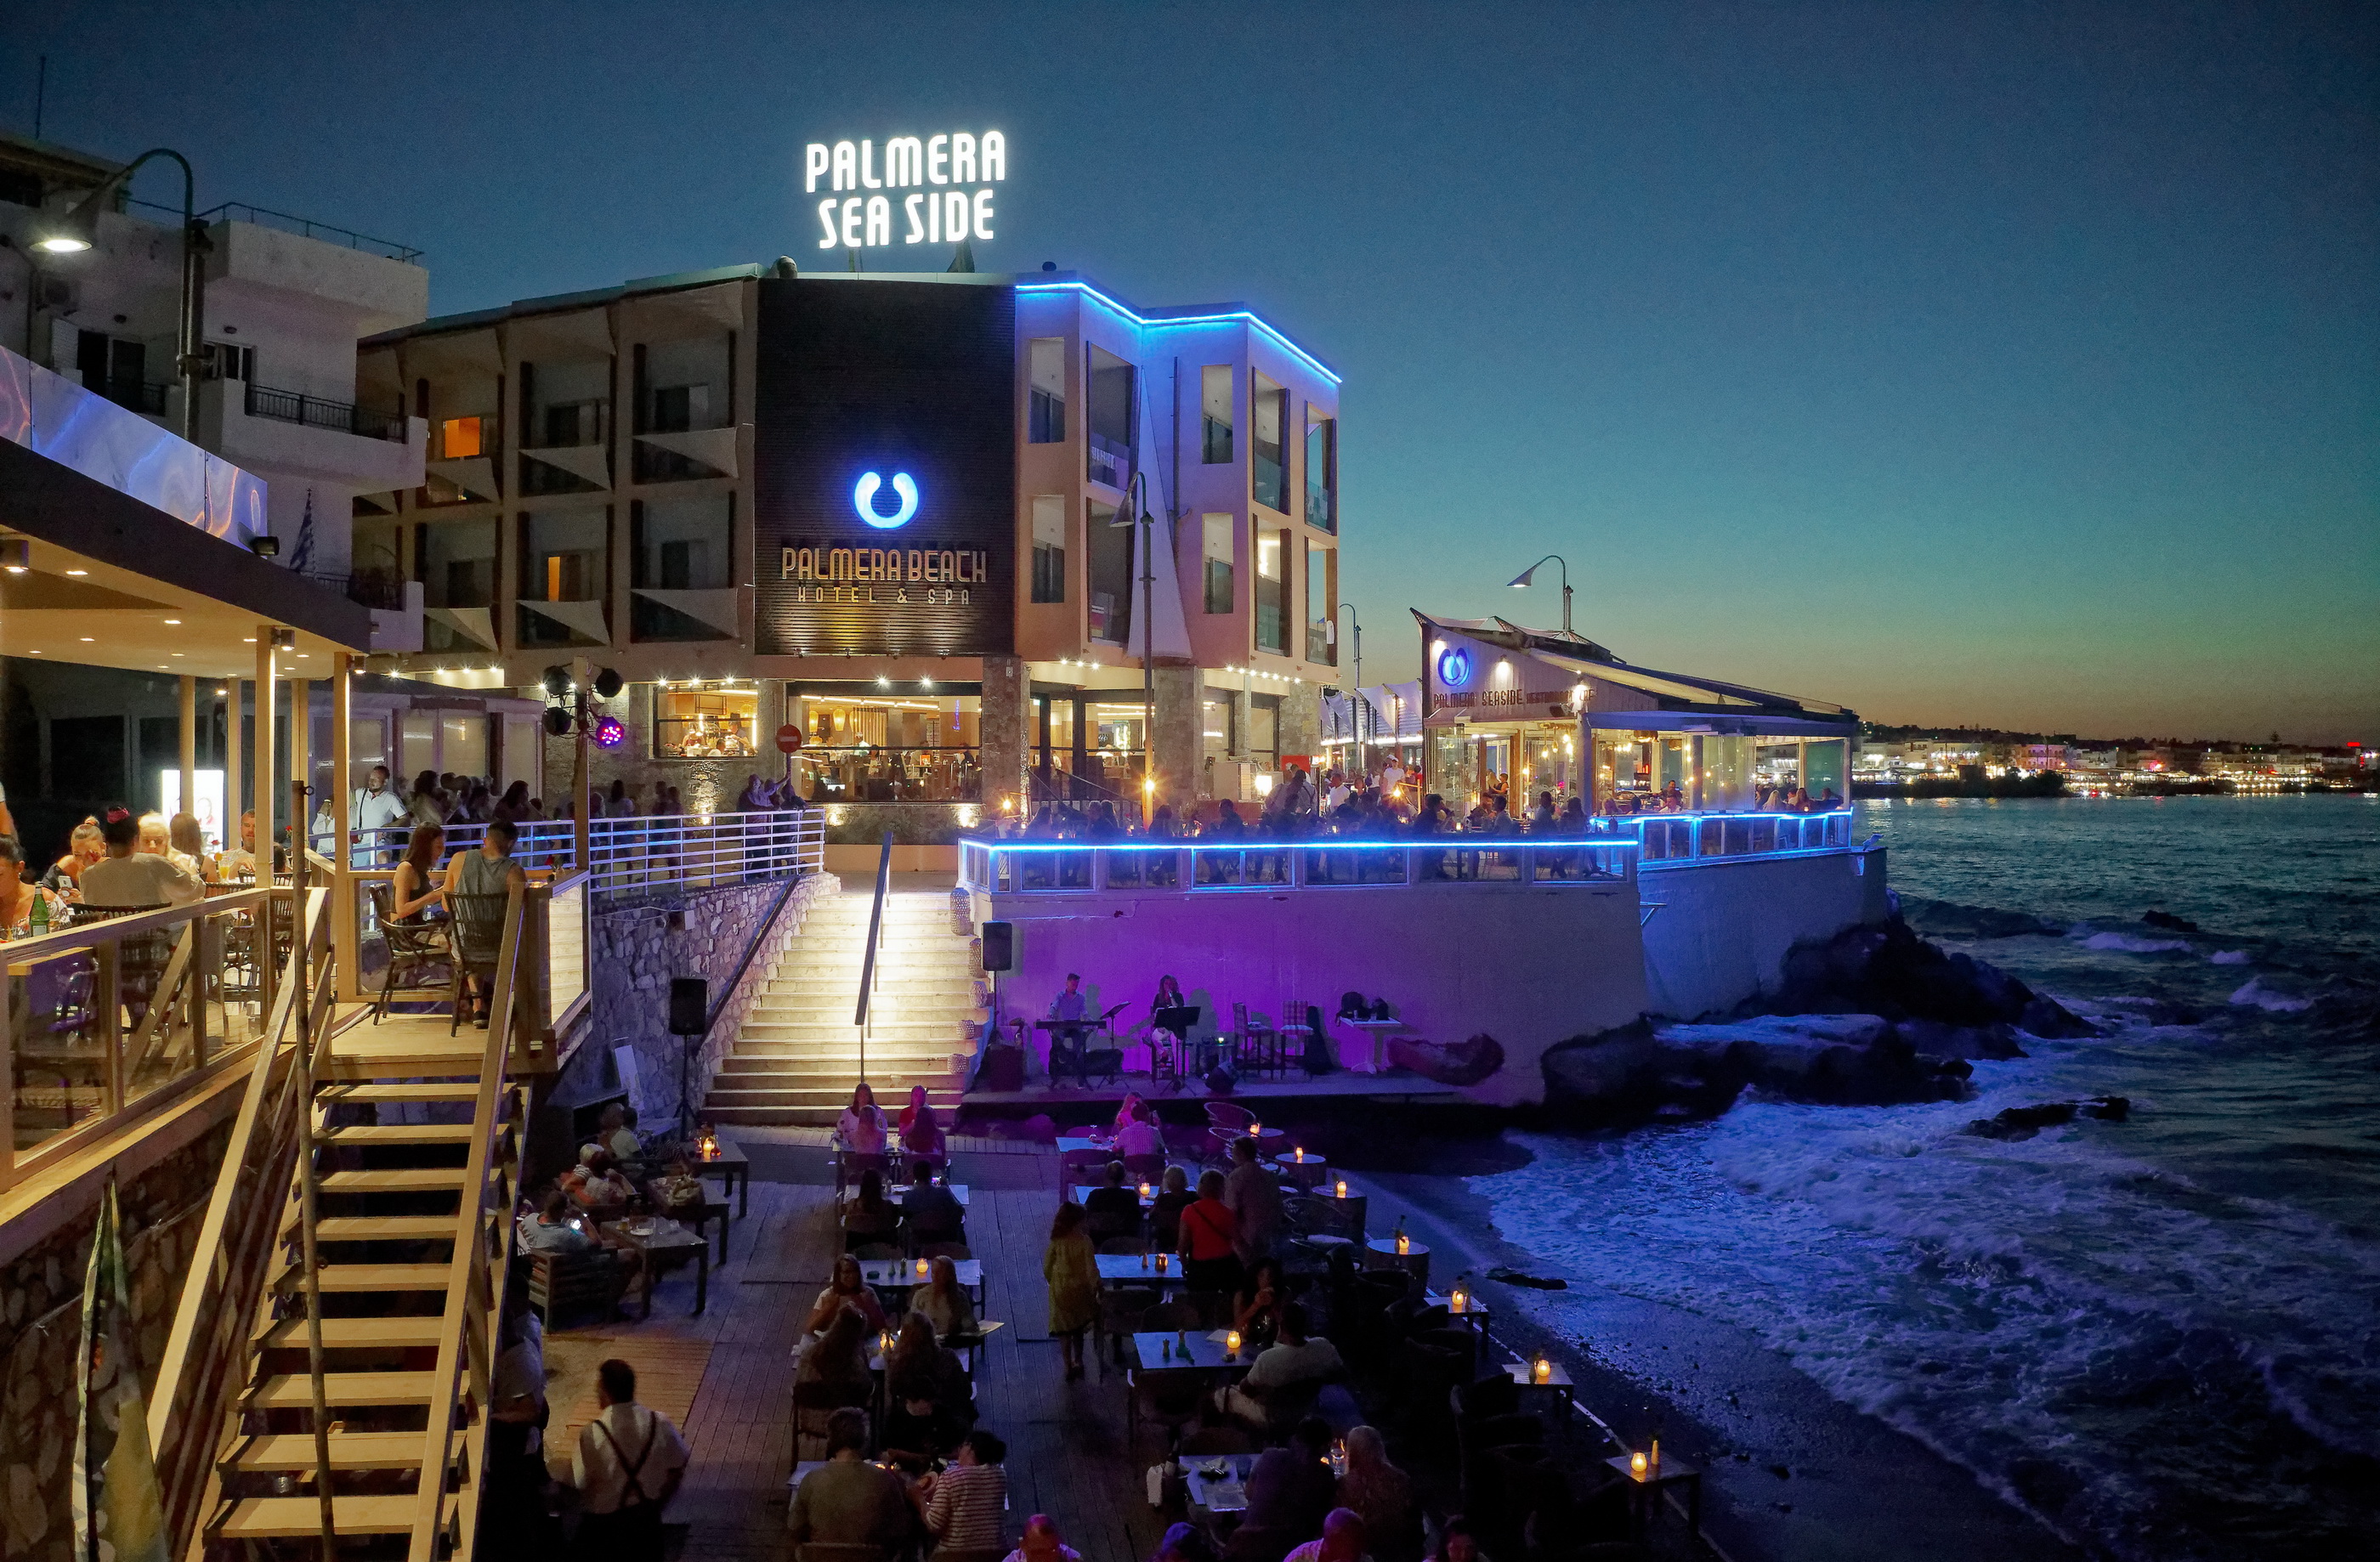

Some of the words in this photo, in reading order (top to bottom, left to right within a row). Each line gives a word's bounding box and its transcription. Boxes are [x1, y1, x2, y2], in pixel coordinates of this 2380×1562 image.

[806, 131, 1006, 193] PALMERA
[819, 195, 890, 249] SEA
[905, 190, 994, 244] SIDE
[782, 547, 902, 581] PALMERA
[908, 550, 986, 583] BEACH
[798, 586, 876, 603] HOTEL
[897, 588, 908, 603] &
[927, 588, 969, 605] SPA
[1482, 688, 1523, 706] SEASIDE
